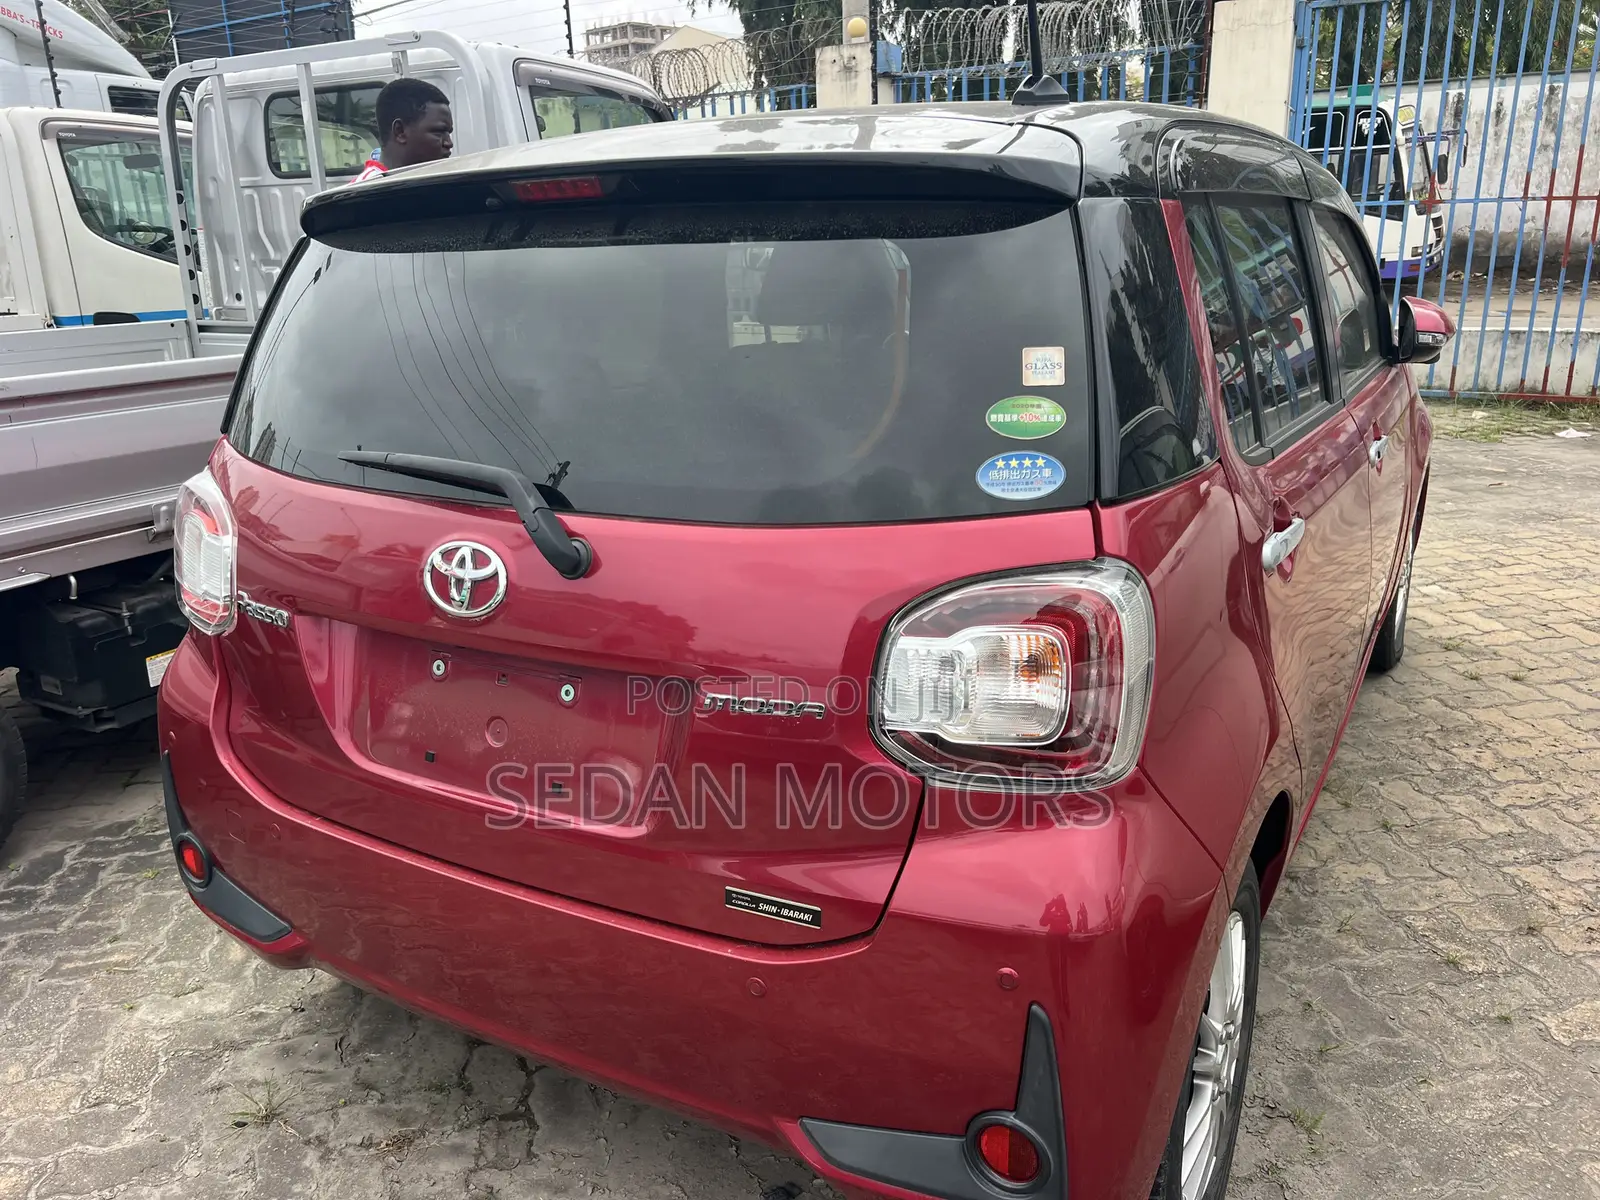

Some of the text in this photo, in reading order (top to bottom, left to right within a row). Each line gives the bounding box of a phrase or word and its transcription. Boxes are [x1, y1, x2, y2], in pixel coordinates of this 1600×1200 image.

[1025, 362, 1063, 370] GLASS
[989, 468, 1053, 481] 低排出ガス車
